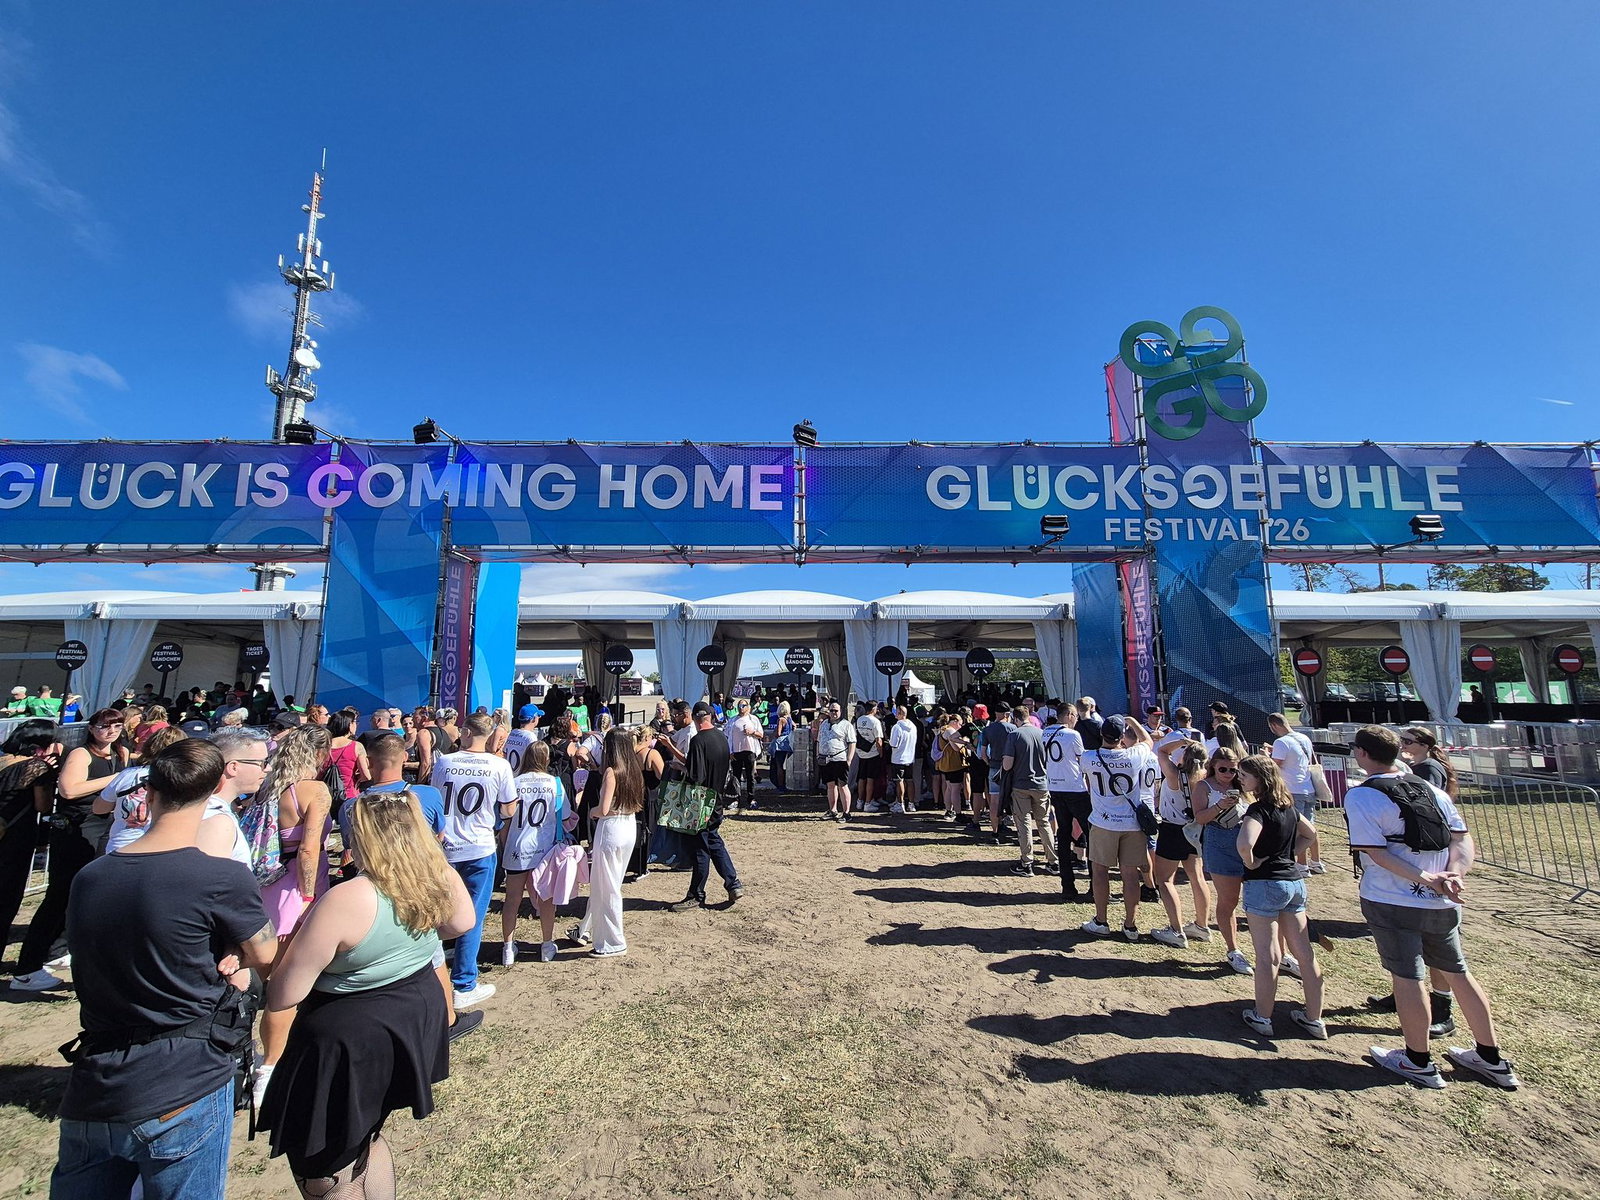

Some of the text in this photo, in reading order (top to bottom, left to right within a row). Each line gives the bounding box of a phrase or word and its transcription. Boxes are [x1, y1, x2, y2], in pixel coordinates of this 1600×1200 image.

[0, 462, 784, 511] GLÜCK IS COMING HOME
[926, 464, 1463, 512] GLÜCKSGEFÜHLE
[1104, 517, 1259, 542] FESTIVAL
[445, 767, 492, 777] PODOLSKI
[1092, 771, 1134, 797] 10
[443, 781, 485, 817] 10
[516, 798, 548, 829] 10
